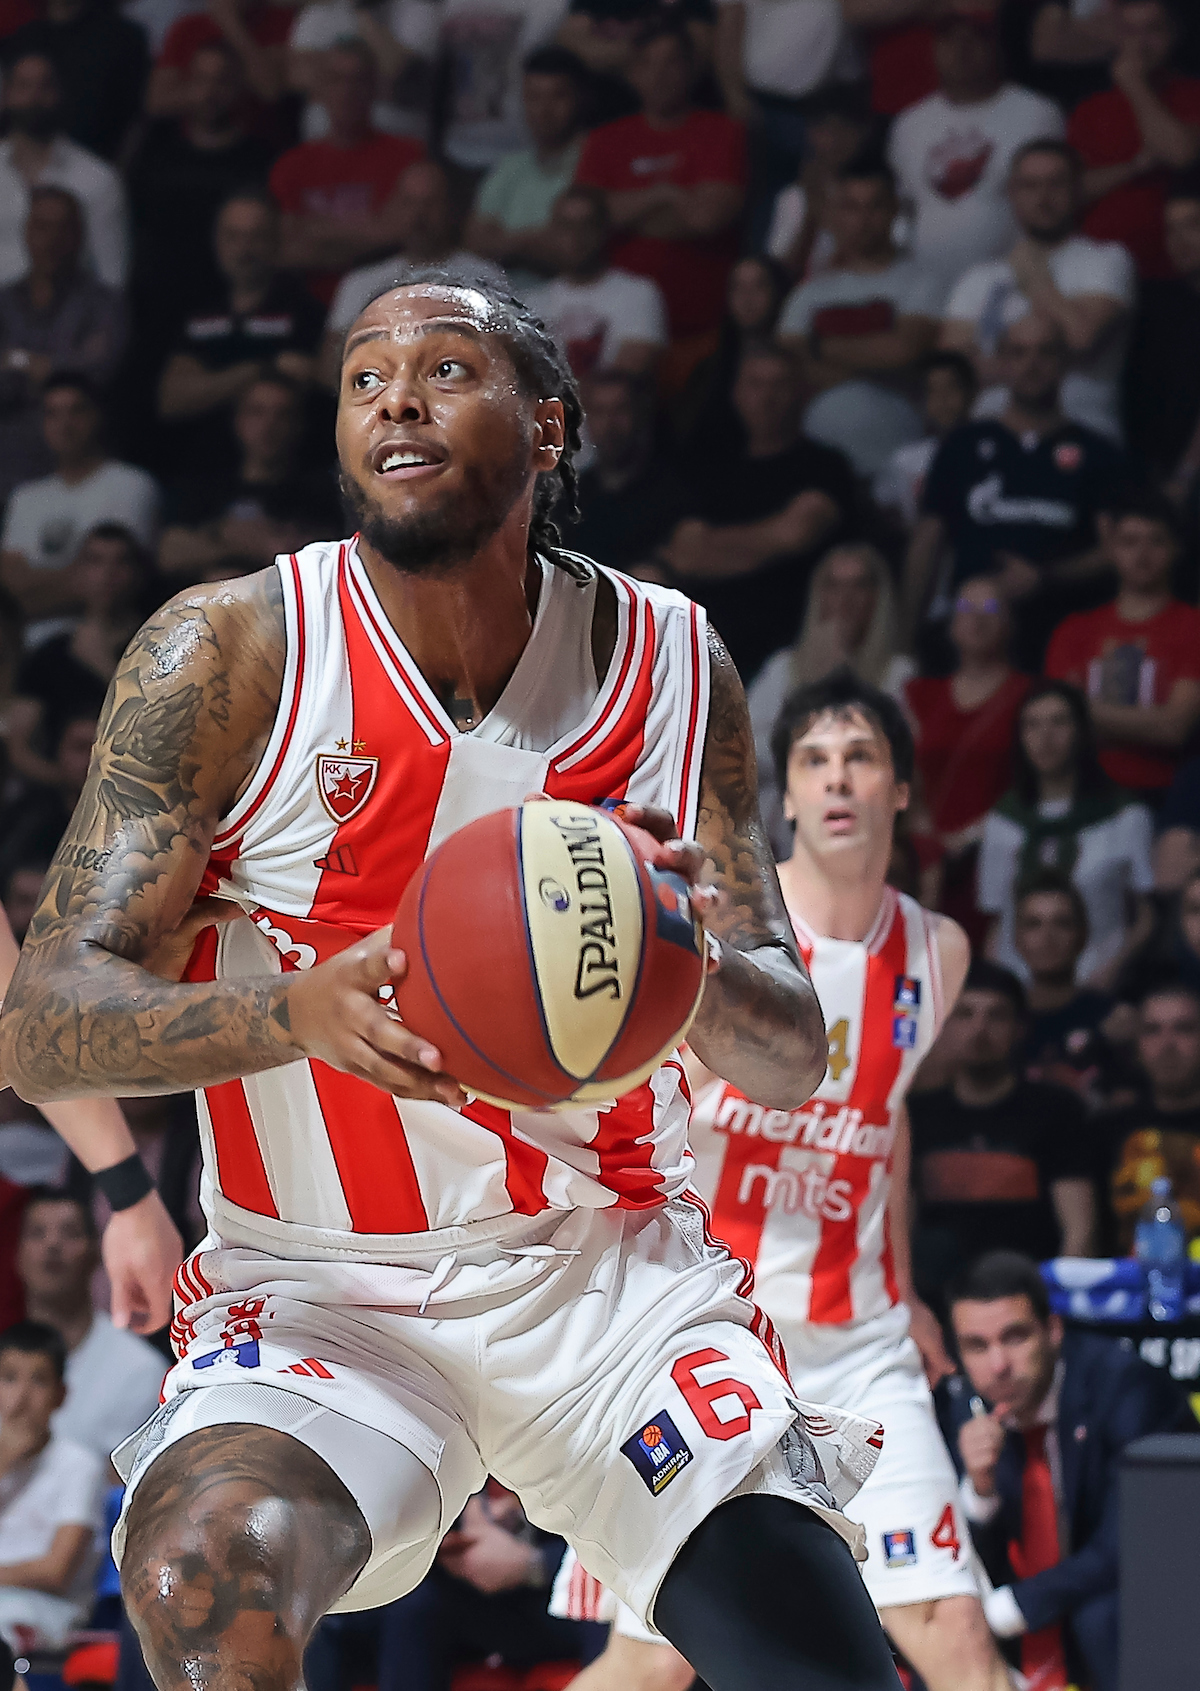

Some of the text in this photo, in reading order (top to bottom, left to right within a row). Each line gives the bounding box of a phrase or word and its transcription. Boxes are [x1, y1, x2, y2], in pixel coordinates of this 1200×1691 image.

[550, 815, 620, 1000] SPALDING
[827, 1018, 850, 1081] 4
[737, 1164, 852, 1222] mts
[670, 1347, 763, 1442] 6
[650, 1442, 671, 1467] ABA
[652, 1449, 689, 1486] ADMIRAL
[931, 1503, 960, 1562] 4
